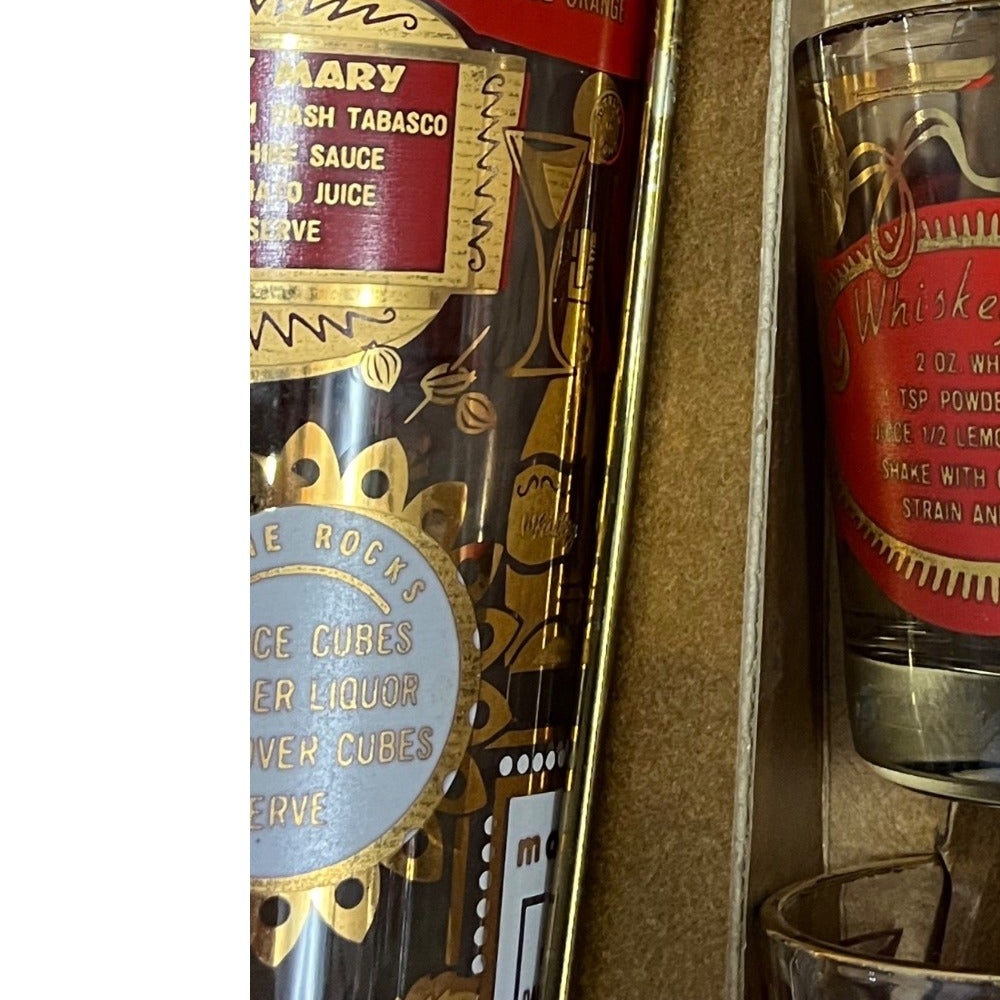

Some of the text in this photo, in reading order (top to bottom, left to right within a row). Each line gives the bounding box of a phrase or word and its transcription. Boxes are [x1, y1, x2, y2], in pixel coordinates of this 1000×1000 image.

[273, 59, 405, 93] MARY
[347, 106, 448, 137] TABASCO
[309, 143, 386, 171] SAUCE
[313, 181, 377, 207] JUICE
[915, 352, 926, 373] 2
[898, 387, 929, 411] TSP
[922, 425, 947, 446] 1/2
[881, 458, 931, 485] SHAKE
[940, 463, 987, 488] WITH
[902, 496, 963, 522] STRAIN
[314, 522, 427, 604] ROCKS
[311, 619, 415, 660] CUBES
[309, 673, 421, 712] LIQUOR
[336, 727, 434, 767] CUBES
